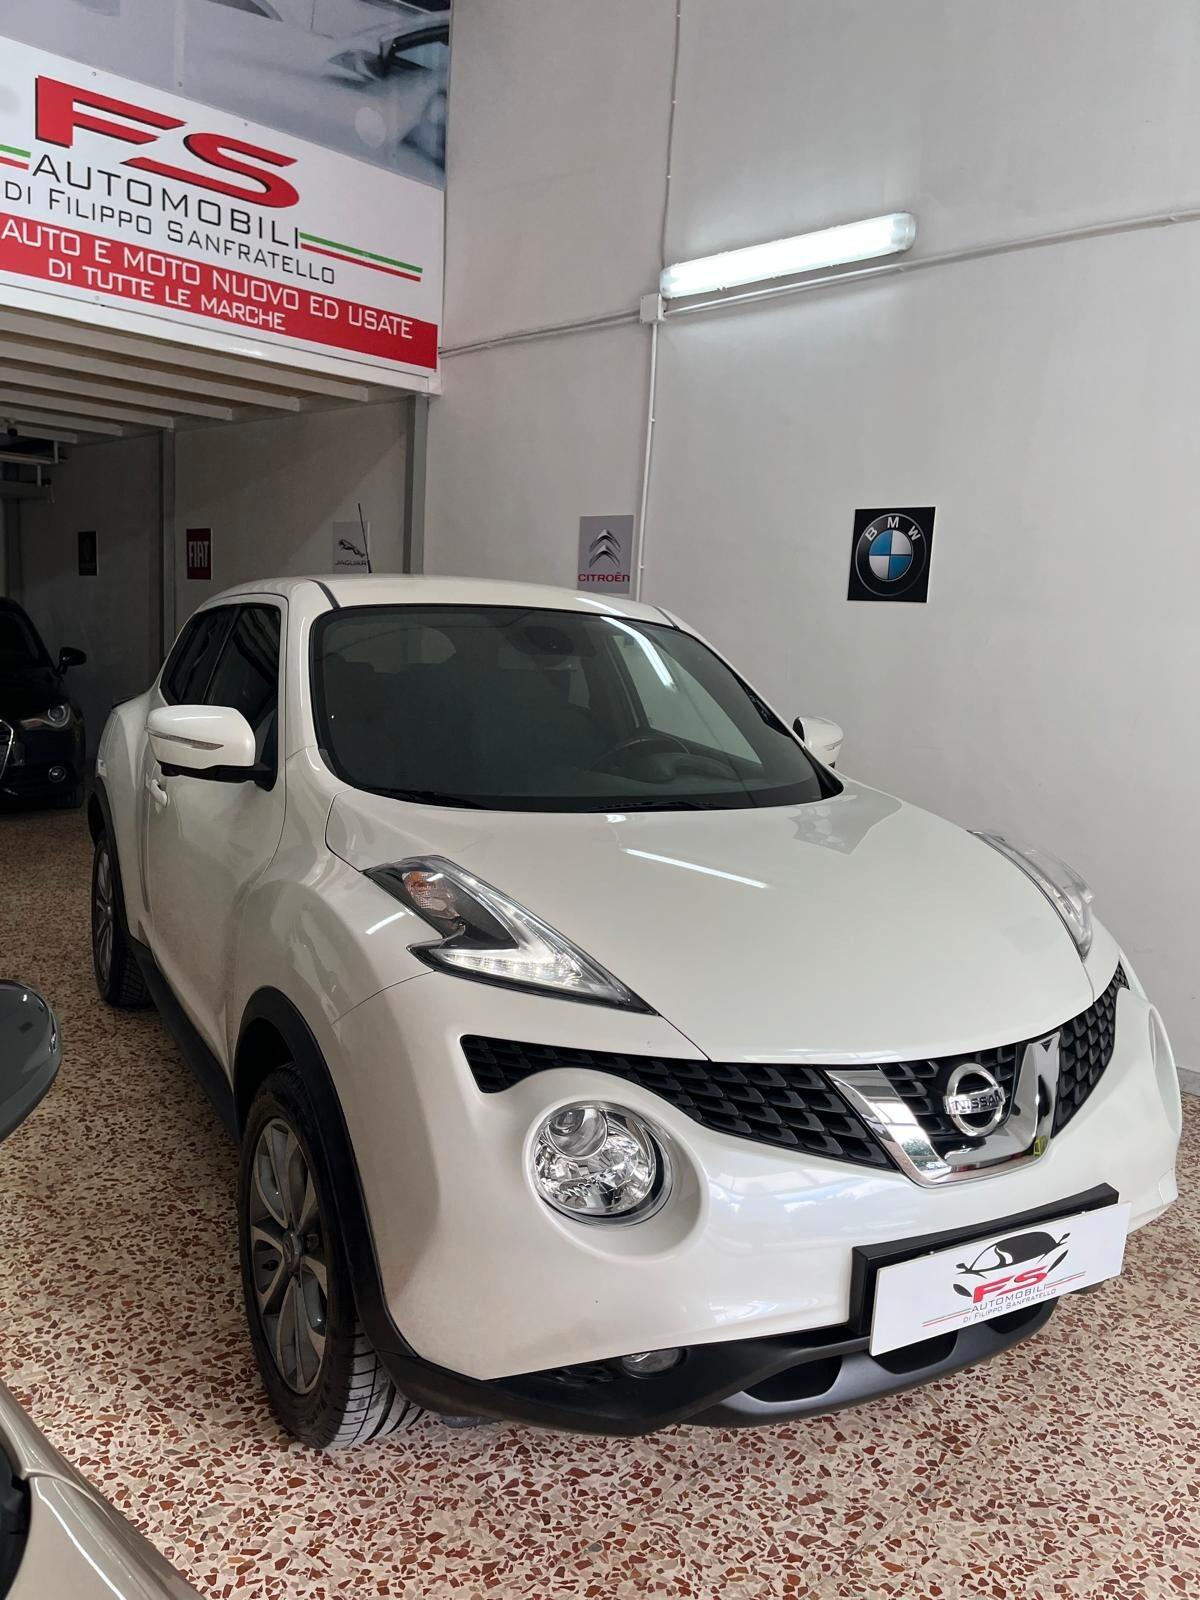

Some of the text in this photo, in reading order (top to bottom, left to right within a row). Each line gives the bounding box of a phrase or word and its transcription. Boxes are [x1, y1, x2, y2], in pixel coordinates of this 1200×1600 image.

[35, 75, 299, 208] FS
[33, 154, 299, 249] AUTOMOBILI
[5, 180, 335, 285] DI FILIPPO SANFRATELLO
[1, 219, 413, 340] AUTO E MOTO NUOVO ED USATE
[48, 258, 286, 331] DI TUTTE LE MARCHE
[865, 516, 921, 541] BMW
[188, 541, 209, 568] FIAT
[951, 1089, 1003, 1113] NISSAN
[971, 1283, 1047, 1313] AUTOMOBILI
[973, 1265, 1047, 1304] FS
[963, 1288, 1057, 1323] DI FILIPPO SANFRATELLO
